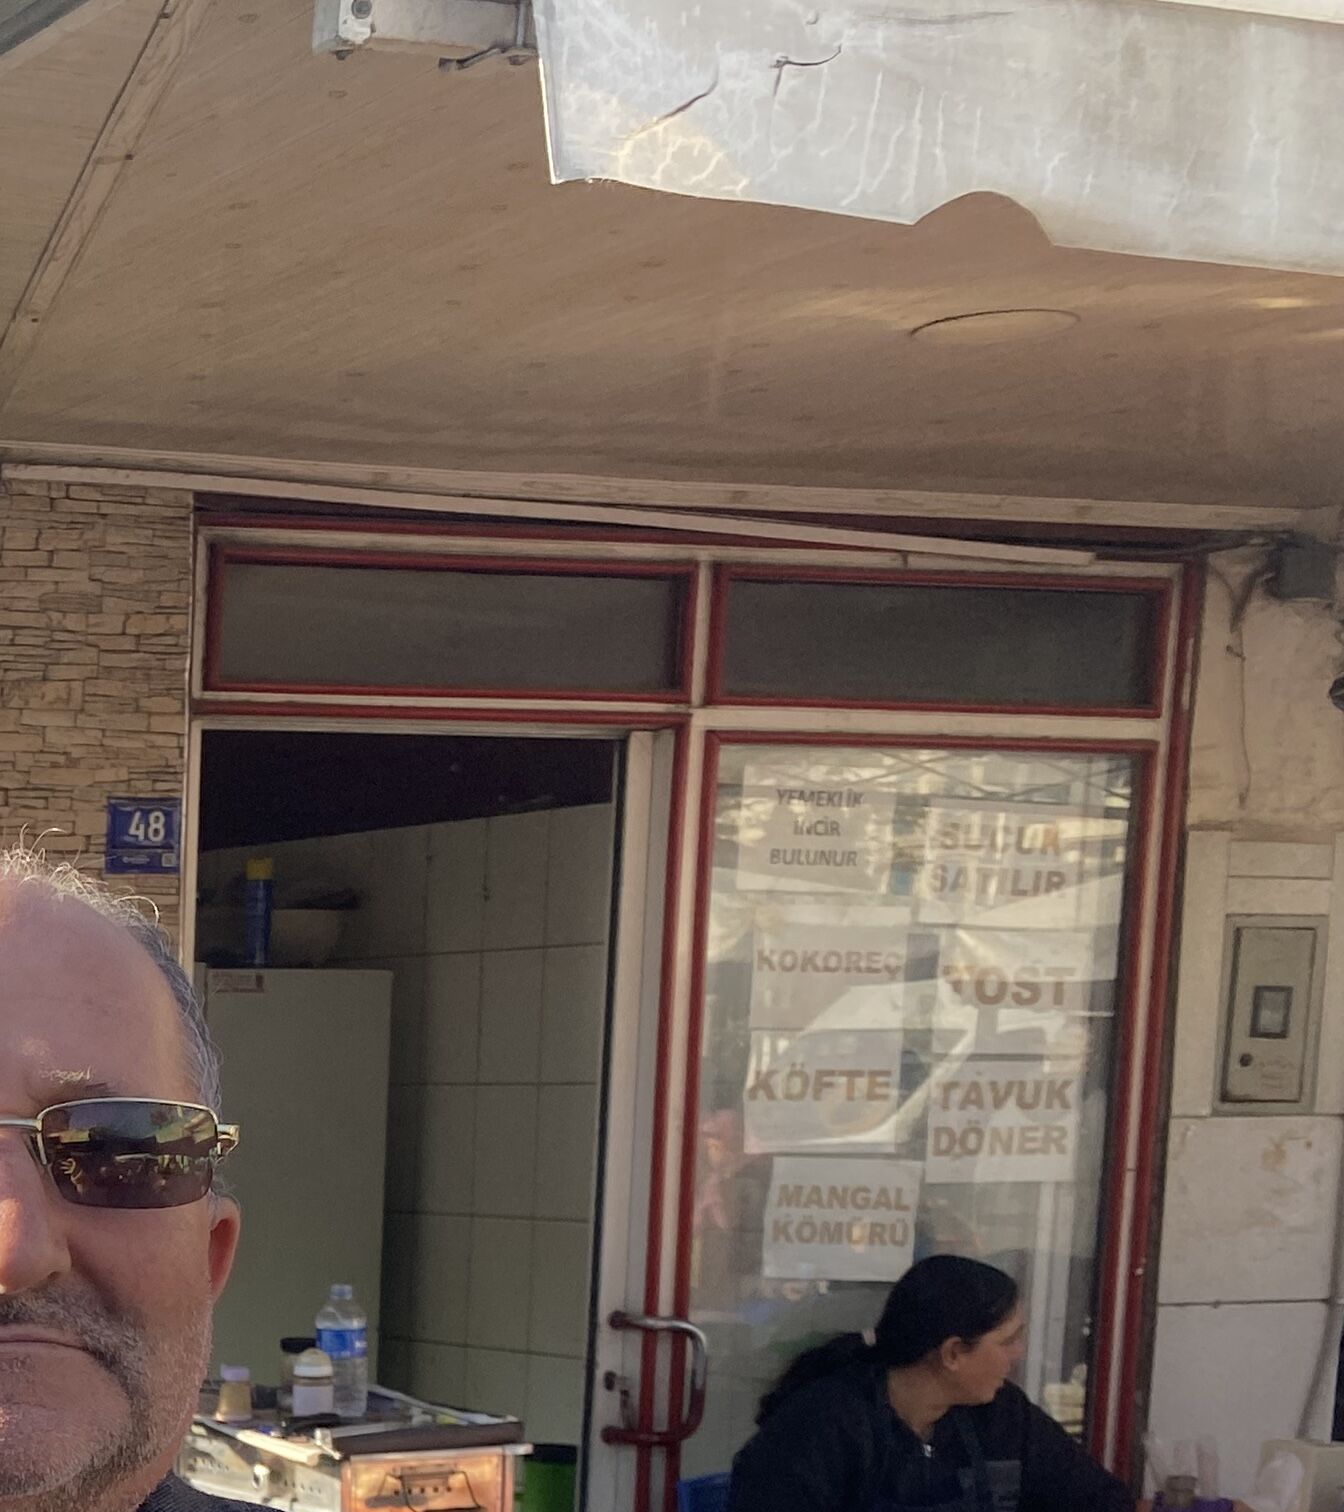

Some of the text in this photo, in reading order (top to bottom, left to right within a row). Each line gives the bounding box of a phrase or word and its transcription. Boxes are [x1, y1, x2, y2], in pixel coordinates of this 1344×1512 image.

[128, 810, 165, 842] 48
[769, 848, 858, 866] BULUNUR
[756, 948, 903, 981] KOKOREÇ
[941, 965, 1076, 1006] TOST
[747, 1062, 893, 1102] KÖFTE
[937, 1077, 1072, 1112] TAVUK
[933, 1121, 1068, 1156] DÖNER
[776, 1184, 910, 1213] MANGAL
[770, 1217, 909, 1248] KÖMÜRÜ
